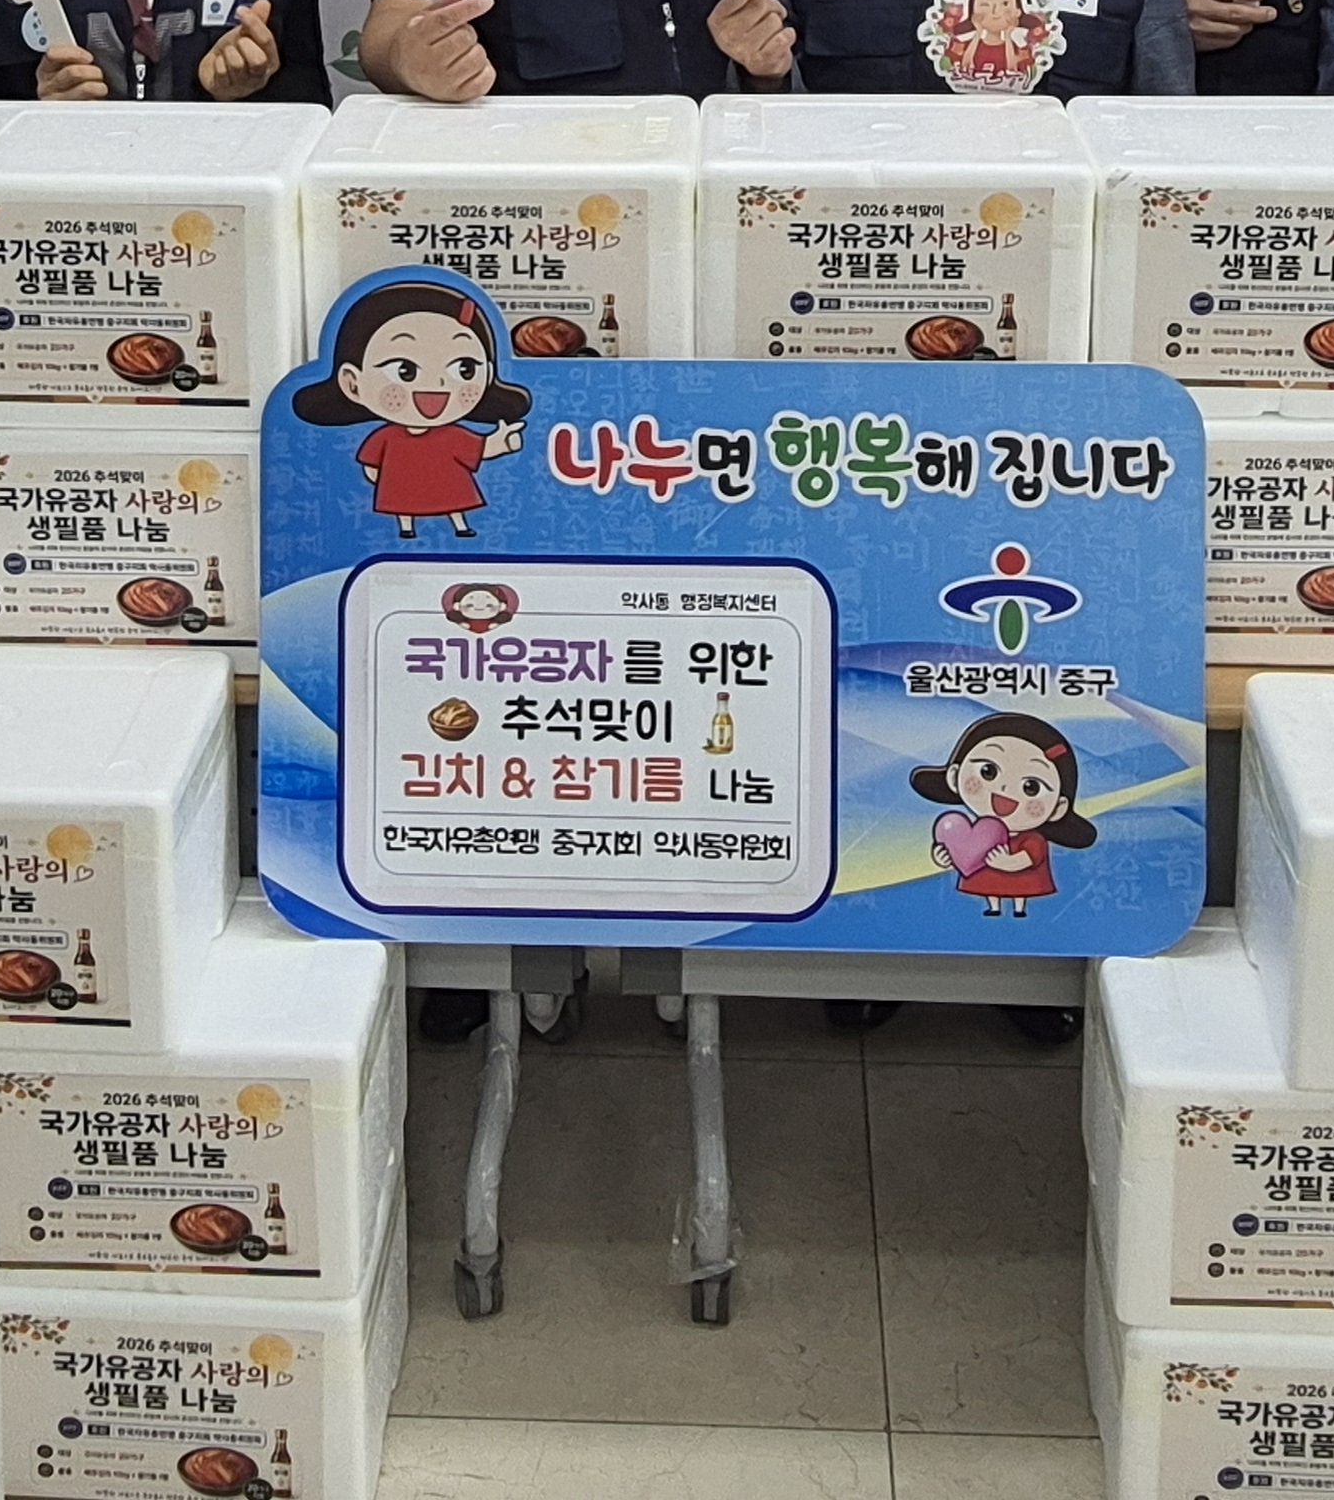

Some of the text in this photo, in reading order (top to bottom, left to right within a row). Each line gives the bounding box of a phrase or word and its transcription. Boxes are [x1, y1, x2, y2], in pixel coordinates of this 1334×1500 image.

[450, 204, 542, 219] 2026 추석맞이
[1255, 205, 1293, 219] 2026
[44, 220, 137, 235] 2026 추석맞이
[388, 223, 596, 251] 국가유공자 사랑의
[787, 222, 998, 251] 국가유공자 사랑의
[1190, 223, 1319, 252] 국가유공자
[116, 239, 192, 268] 사랑의
[512, 253, 567, 280] 나눔
[817, 252, 967, 280] 생필품 나눔
[1219, 253, 1303, 281] 생필품
[15, 268, 163, 297] 생필품 나눔
[552, 414, 1170, 504] 나누면 행복해 집니다
[54, 469, 144, 484] 2026 추석맞이
[1206, 476, 1308, 502] 가유공자
[124, 488, 197, 515] 사랑의
[26, 515, 170, 543] 생필품 나눔
[1210, 504, 1293, 531] 생필품
[620, 591, 778, 612] 약사동 행정복지센터
[404, 637, 614, 684] 국가유공자
[689, 641, 774, 687] 위한
[906, 664, 1116, 697] 울산광역시 중구
[501, 695, 673, 743] 추석맞이
[400, 752, 775, 805] 김치 & 참기름 나눔
[383, 824, 791, 862] 한국자유총연맹 중구지회 약사동위원회
[102, 1092, 200, 1108] 2026 추석맞이
[38, 1110, 258, 1141] 국가유공자 사랑의
[72, 1139, 228, 1169] 생필품 나눔
[52, 1351, 269, 1389] 국가유공자 사랑의
[84, 1381, 238, 1414] 생필품 나눔
